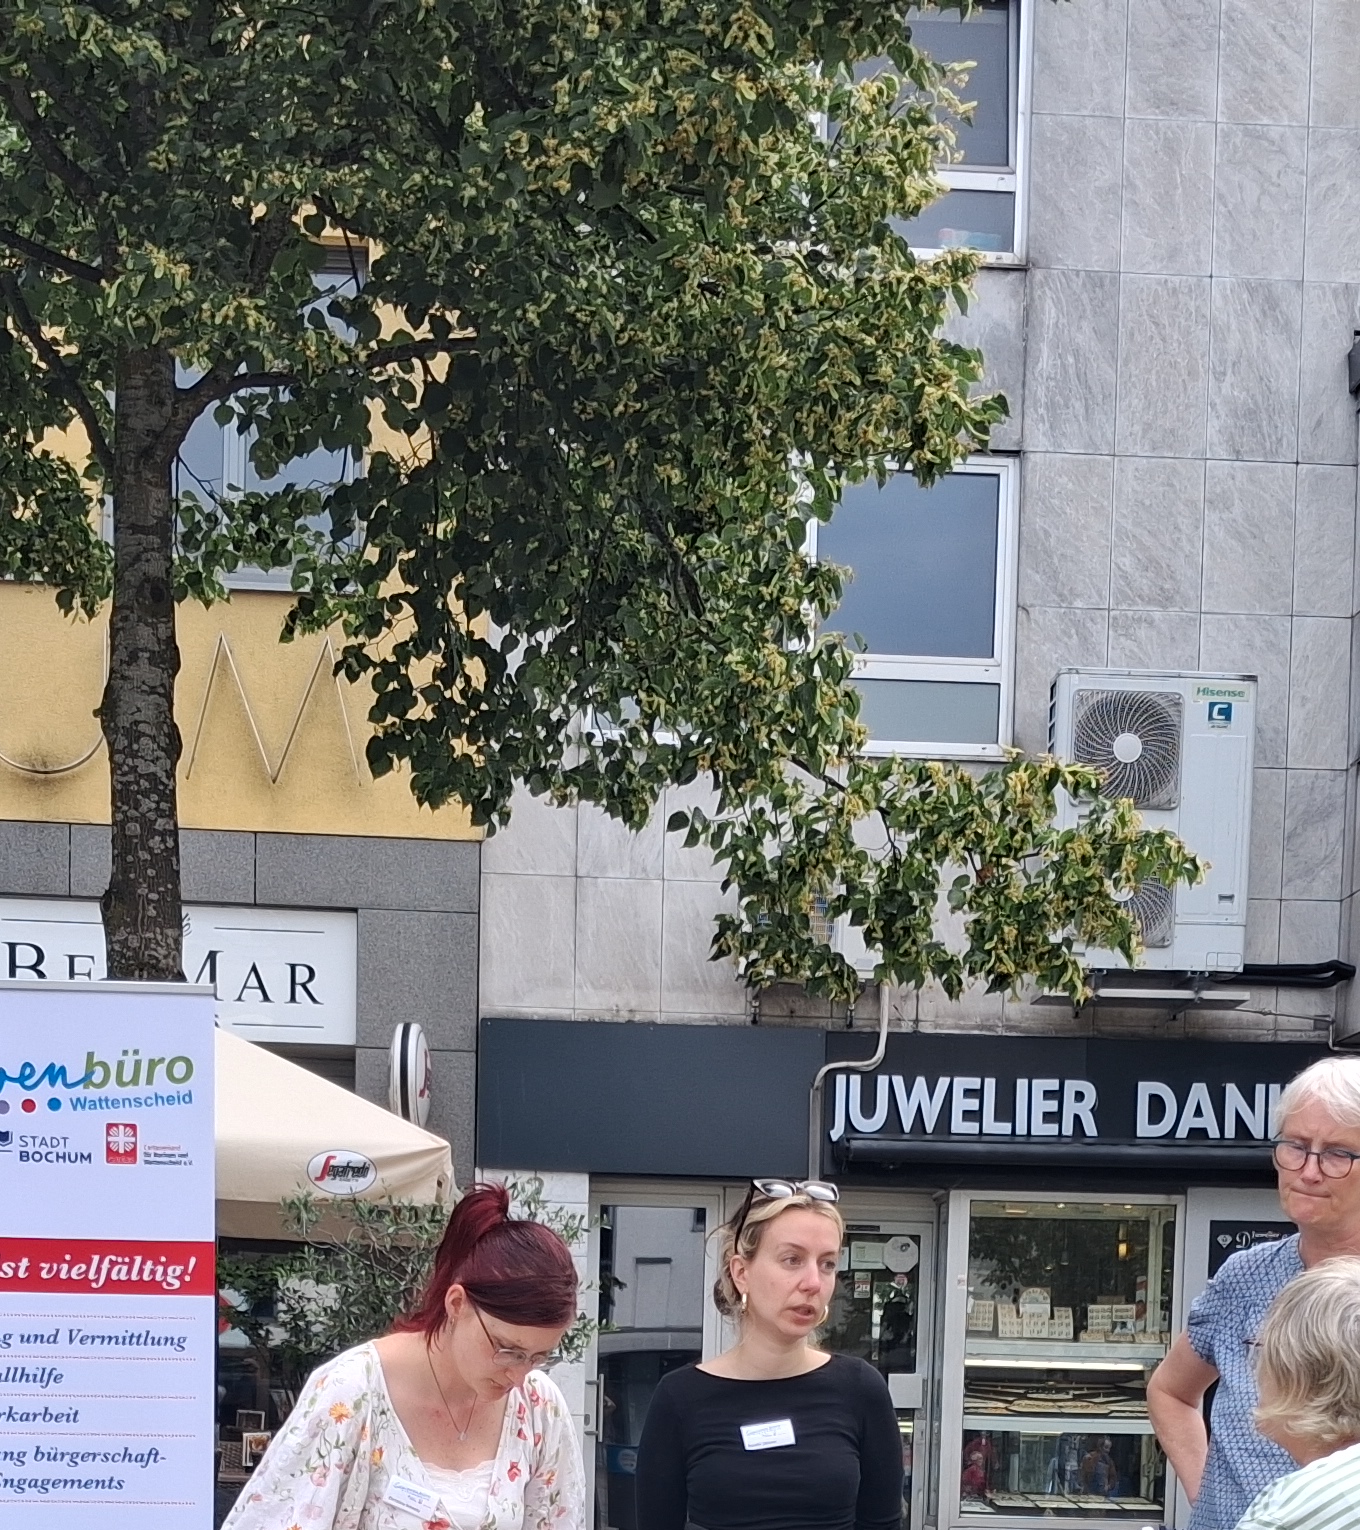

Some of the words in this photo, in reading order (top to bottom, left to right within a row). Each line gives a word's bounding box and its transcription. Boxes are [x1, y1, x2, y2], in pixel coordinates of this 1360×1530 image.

[1197, 687, 1246, 698] Hisense
[69, 1090, 193, 1111] Wattenscheid
[830, 1074, 1099, 1142] JUWELIER
[19, 1135, 70, 1149] STADT
[19, 1150, 92, 1164] BOCHUM
[314, 1155, 371, 1183] Segafredo
[39, 1253, 197, 1292] vielfältig!
[19, 1327, 59, 1346] und
[68, 1329, 188, 1352] Vermittlung
[33, 1445, 167, 1470] bürgerschaft-
